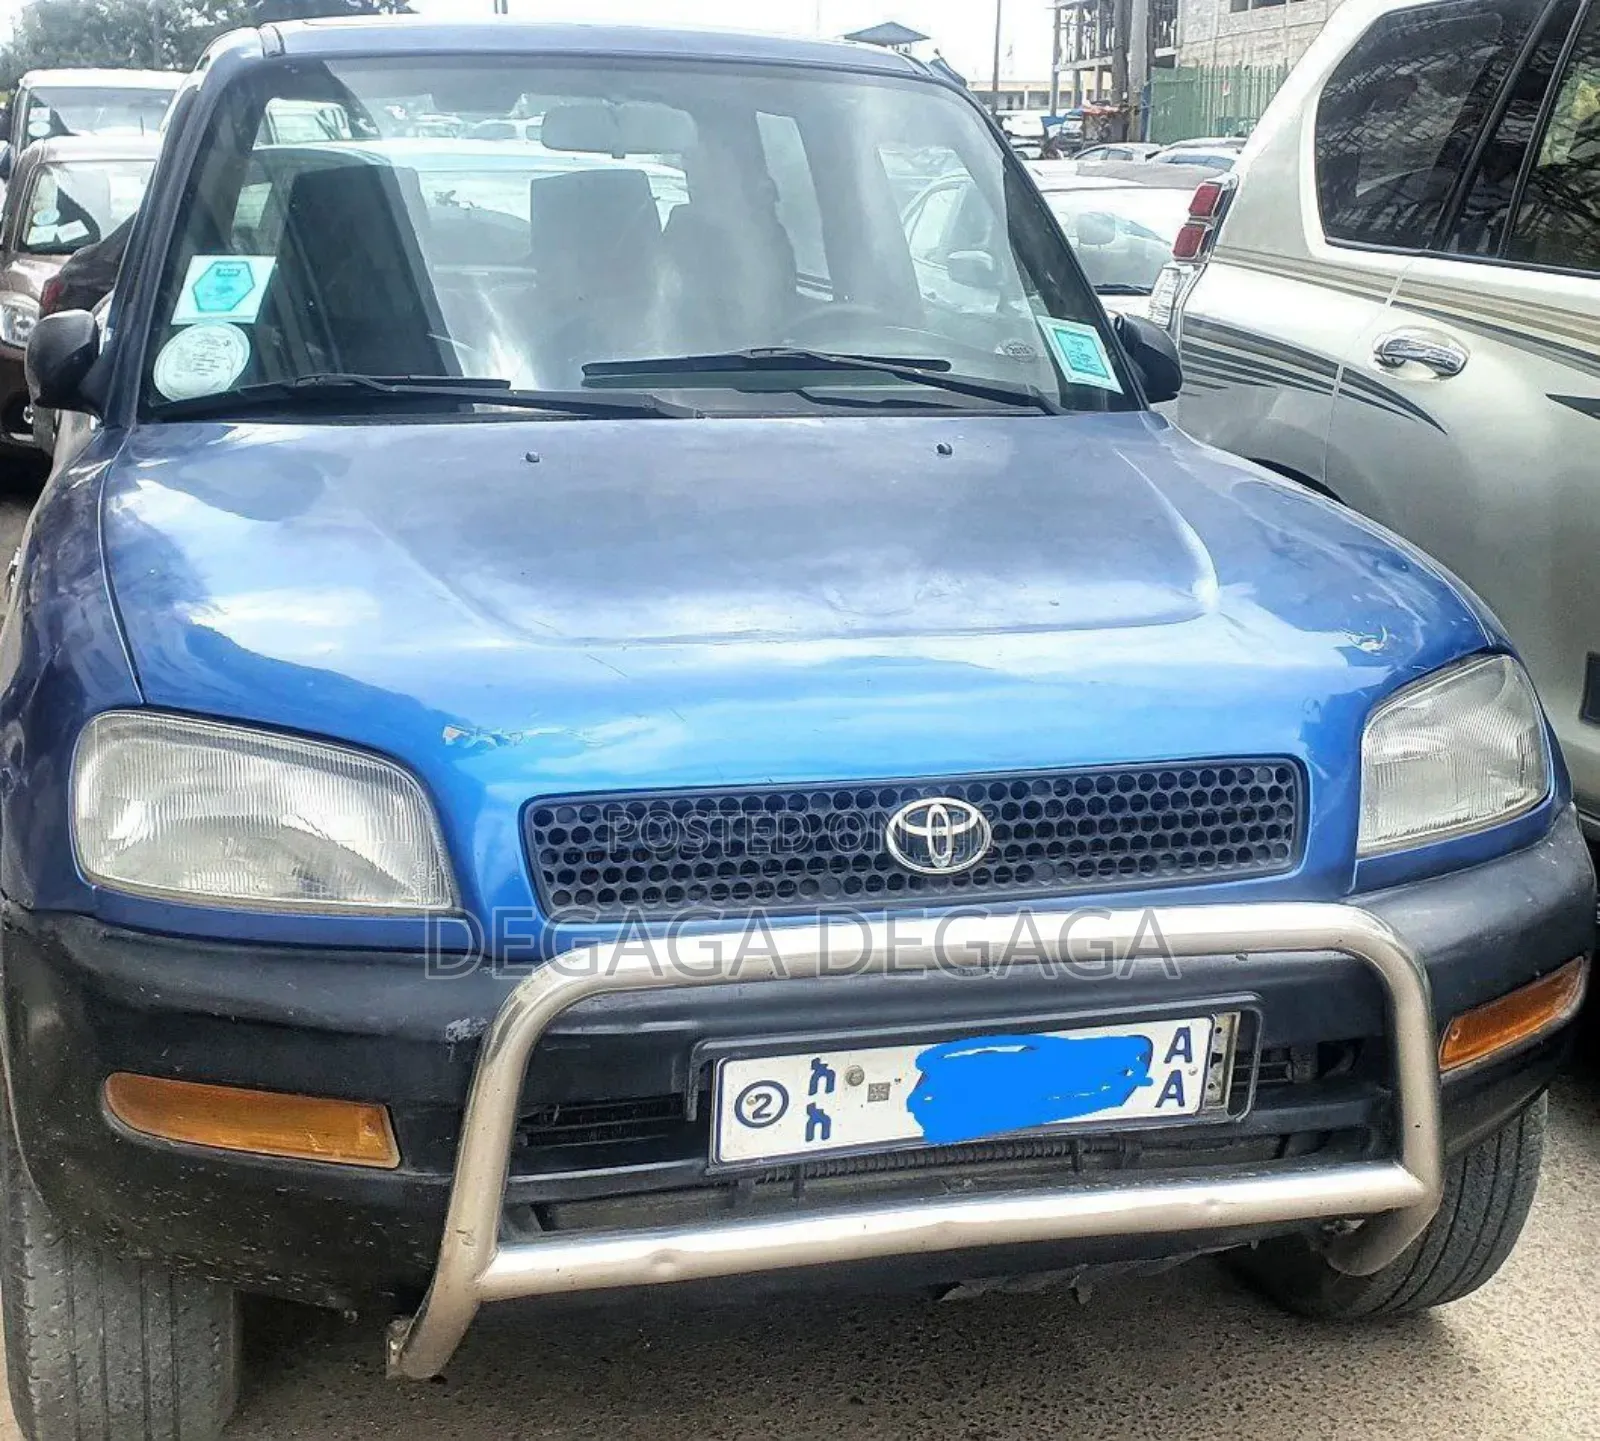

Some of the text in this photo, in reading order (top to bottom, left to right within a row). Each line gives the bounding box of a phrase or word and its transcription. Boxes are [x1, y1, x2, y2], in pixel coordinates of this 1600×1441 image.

[1163, 1026, 1193, 1064] A
[752, 1093, 772, 1119] 2
[1154, 1069, 1186, 1108] A
